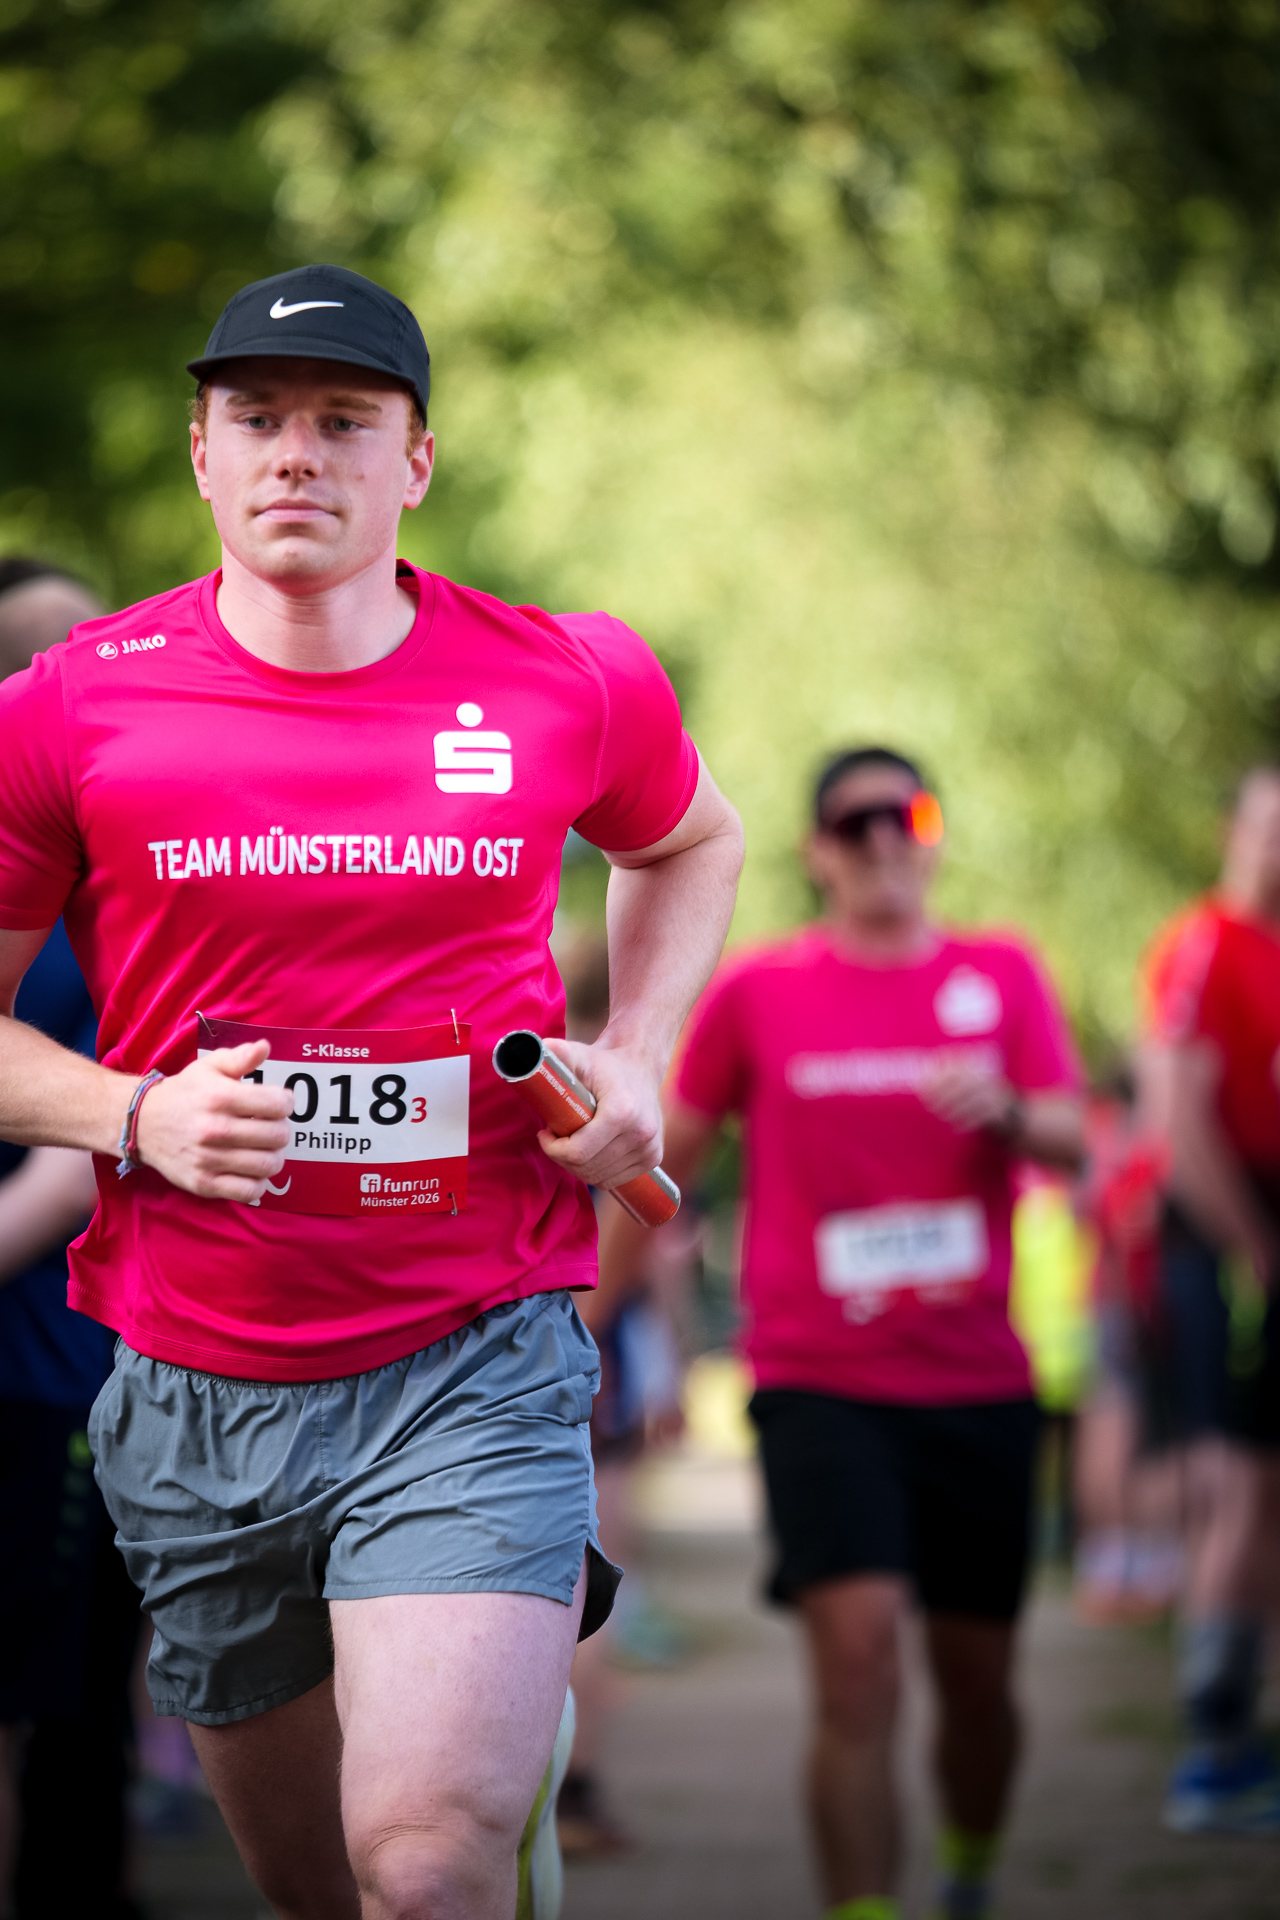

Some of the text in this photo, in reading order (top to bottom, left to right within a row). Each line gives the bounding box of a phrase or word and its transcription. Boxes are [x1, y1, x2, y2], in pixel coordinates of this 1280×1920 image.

[121, 634, 167, 655] JAKO
[148, 826, 524, 881] TEAM MÜNSTERLAND OST
[302, 1043, 371, 1058] S-Klasse
[294, 1131, 372, 1155] Philipp
[383, 1178, 440, 1193] funrun
[360, 1192, 440, 1207] Münster 2026
